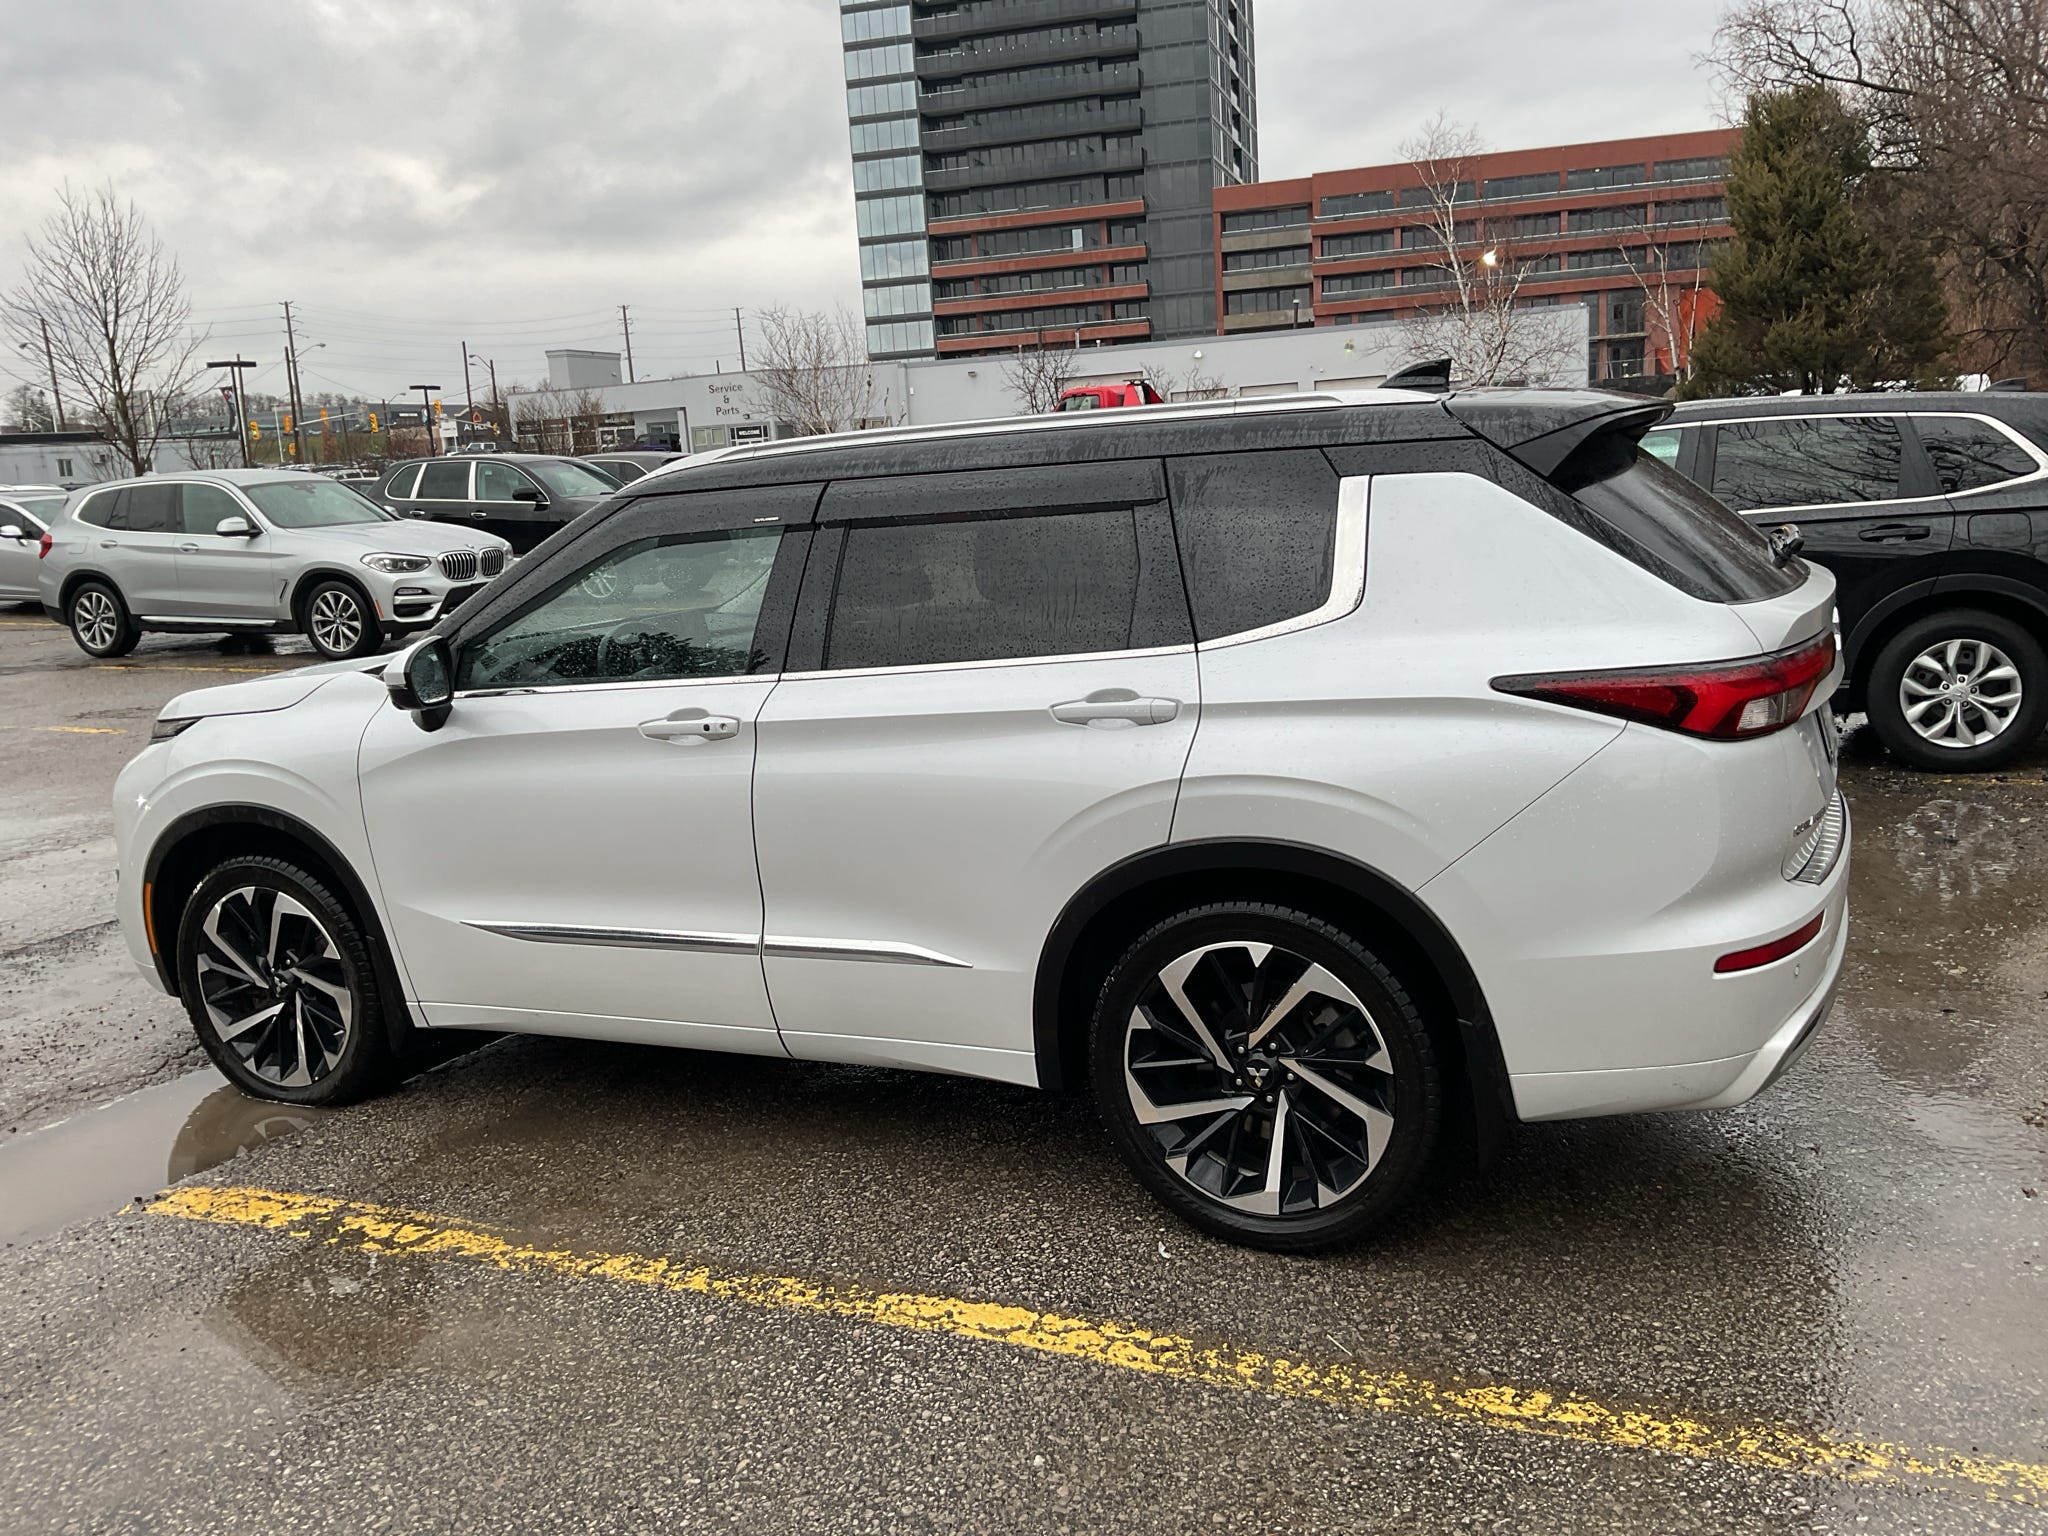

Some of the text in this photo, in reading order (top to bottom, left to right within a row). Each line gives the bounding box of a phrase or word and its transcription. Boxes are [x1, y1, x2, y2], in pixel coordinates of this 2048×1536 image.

[708, 383, 743, 394] Service
[723, 395, 730, 404] &
[716, 406, 740, 416] Parts
